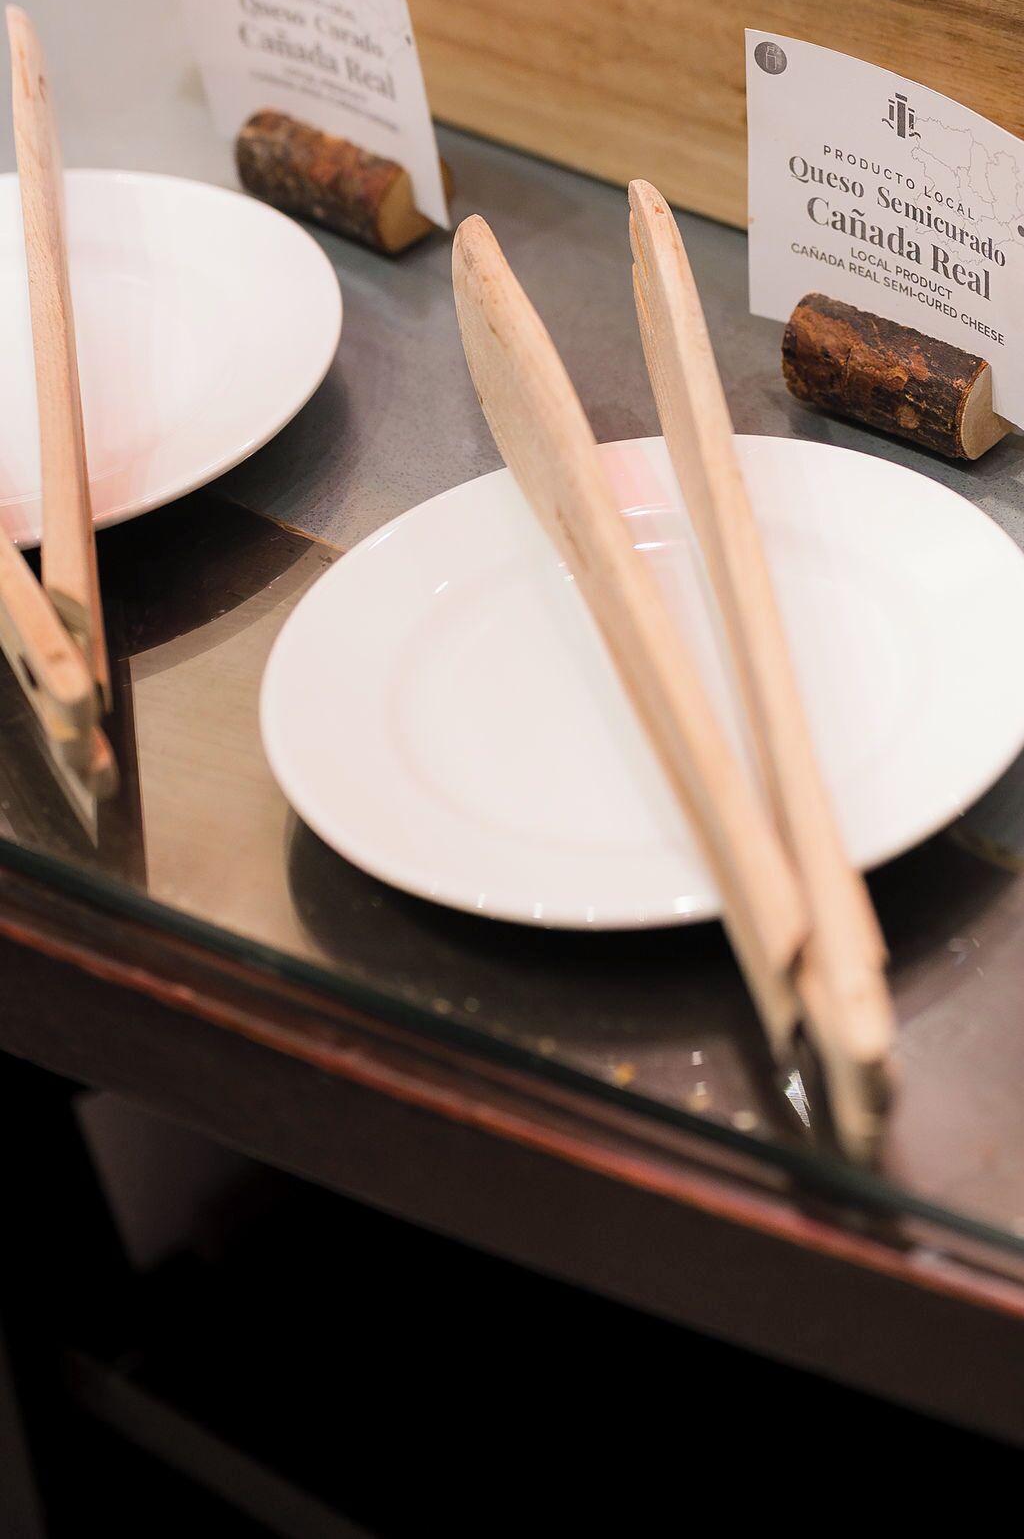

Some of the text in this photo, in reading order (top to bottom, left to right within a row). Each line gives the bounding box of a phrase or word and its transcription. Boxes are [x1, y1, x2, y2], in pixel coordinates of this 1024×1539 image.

[238, 22, 340, 74] Cañada
[345, 56, 397, 102] Real
[314, 14, 385, 58] Curado
[788, 155, 1006, 267] Queso Semicurado
[823, 144, 975, 221] PRODUCTO LOCAL
[806, 197, 992, 302] Cañada Real
[850, 247, 953, 300] LOCAL PRODUCT
[790, 242, 1005, 346] CAÑADA REAL SEMI-CURED CHEESE
